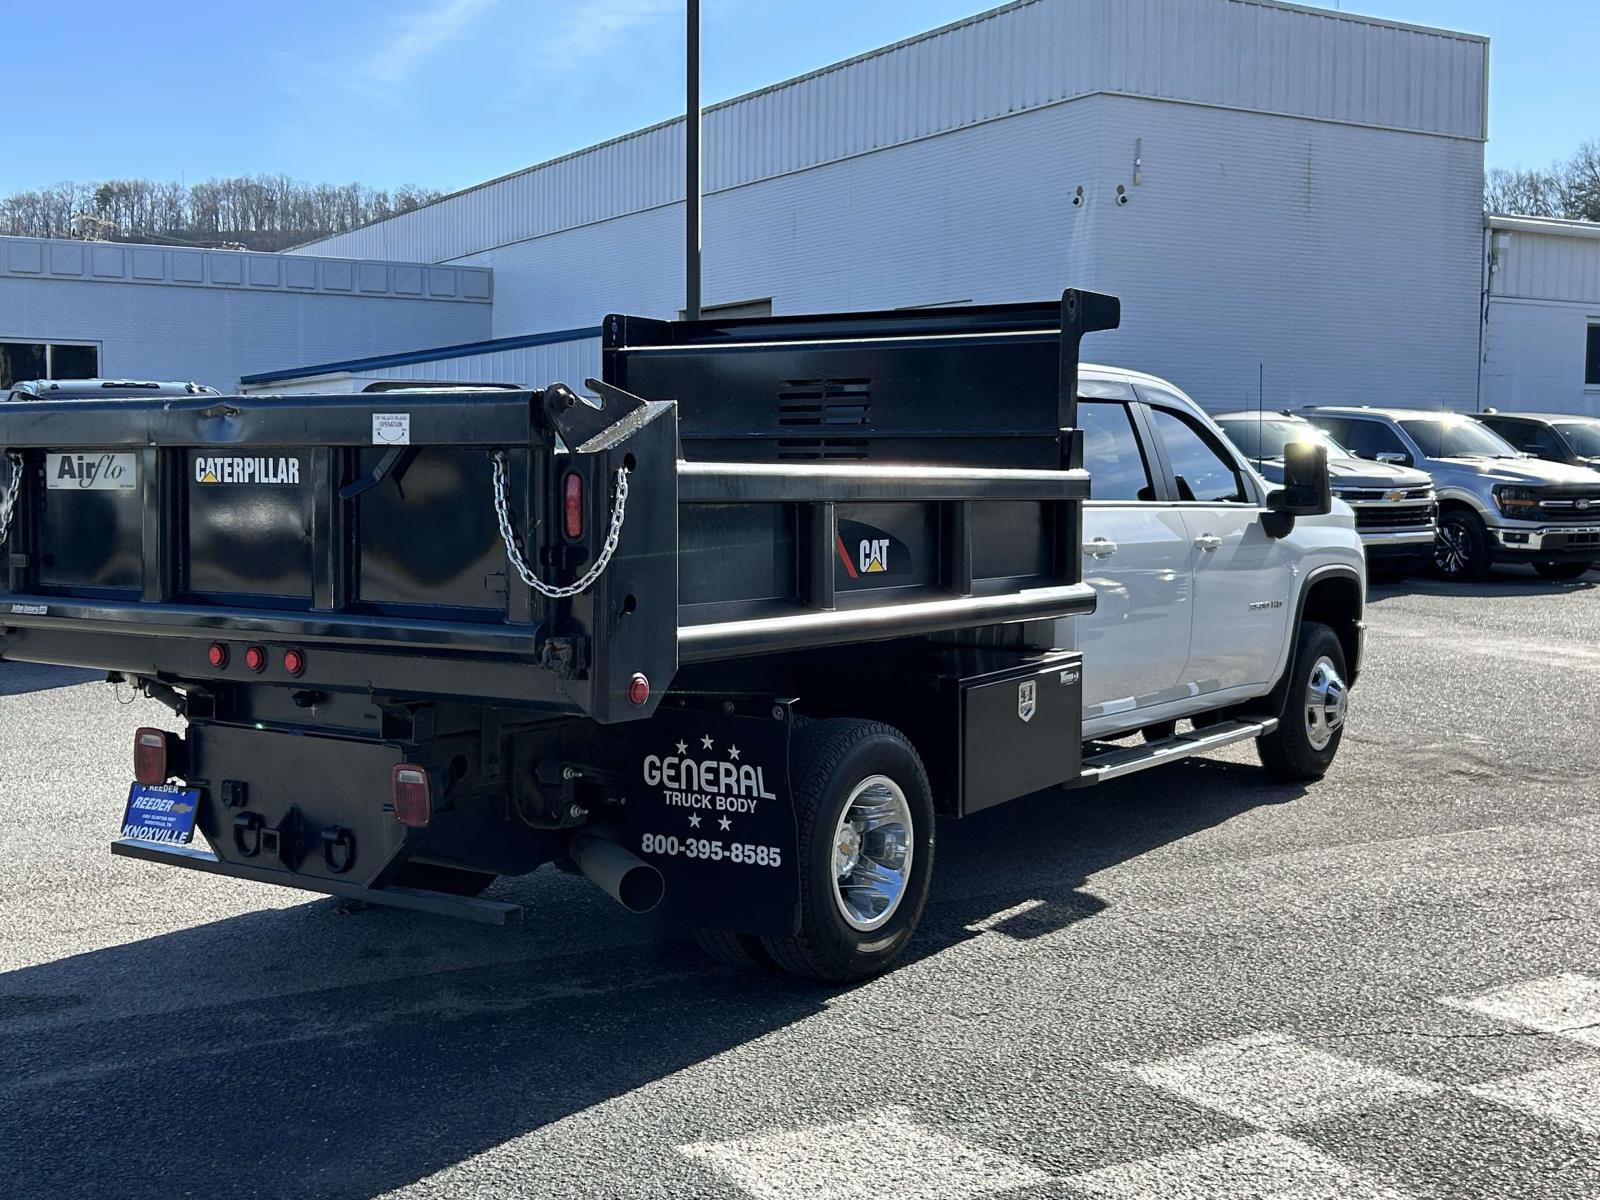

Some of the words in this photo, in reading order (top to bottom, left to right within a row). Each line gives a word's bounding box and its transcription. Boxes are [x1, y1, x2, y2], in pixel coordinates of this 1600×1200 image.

[57, 454, 123, 488] Airflo
[195, 457, 300, 483] CATERPILLAR
[859, 538, 890, 573] CAT
[643, 754, 777, 801] GENERAL
[132, 796, 175, 812] REEDER
[663, 790, 712, 810] TRUCK
[715, 796, 757, 814] BODY
[122, 824, 189, 844] KNOXVILLE
[641, 833, 782, 868] 800-395-8585
